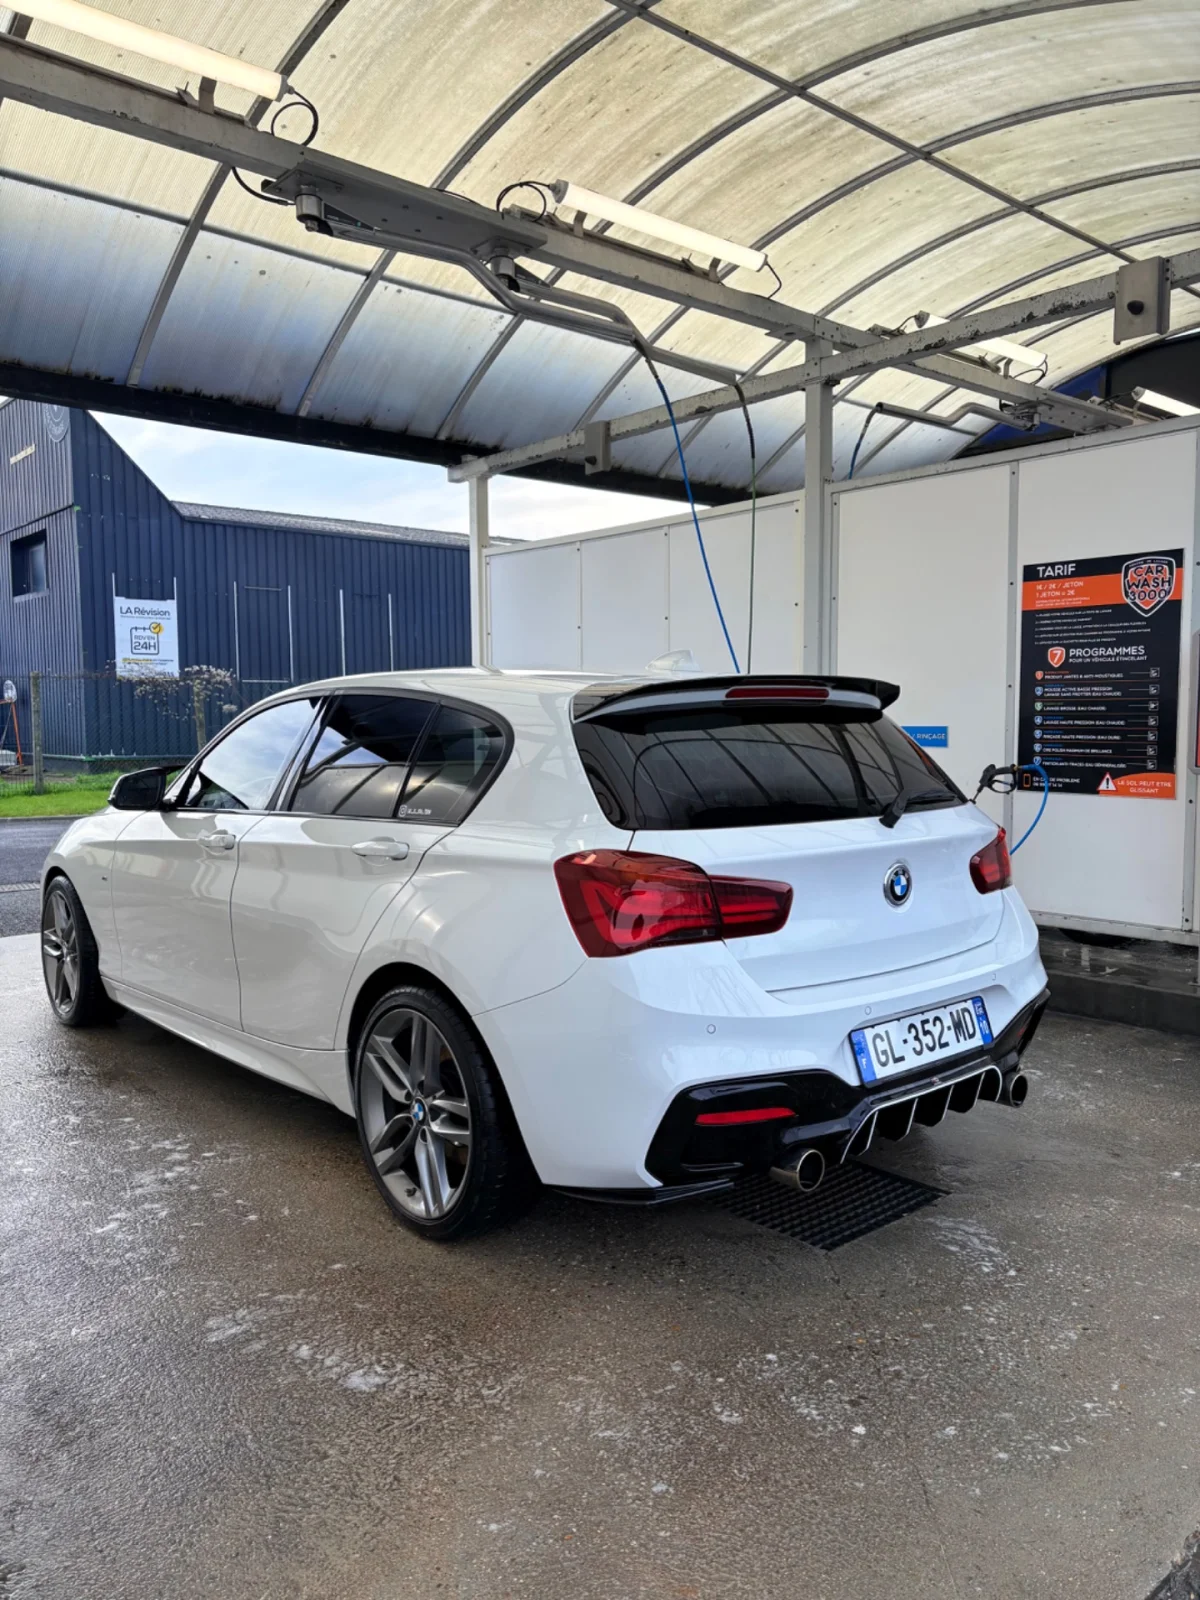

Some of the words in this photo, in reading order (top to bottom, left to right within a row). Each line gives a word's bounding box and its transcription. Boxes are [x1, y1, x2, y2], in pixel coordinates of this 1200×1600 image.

[1036, 563, 1076, 578] TARIF
[1134, 565, 1164, 576] CAR
[1126, 576, 1172, 589] WASH
[1129, 589, 1167, 601] 3000
[120, 606, 132, 615] LA
[134, 606, 170, 616] Révision
[134, 641, 156, 651] 24H
[1069, 646, 1145, 657] PROGRAMMES
[1053, 650, 1061, 663] 7
[872, 1007, 977, 1067] GL-352-MD
